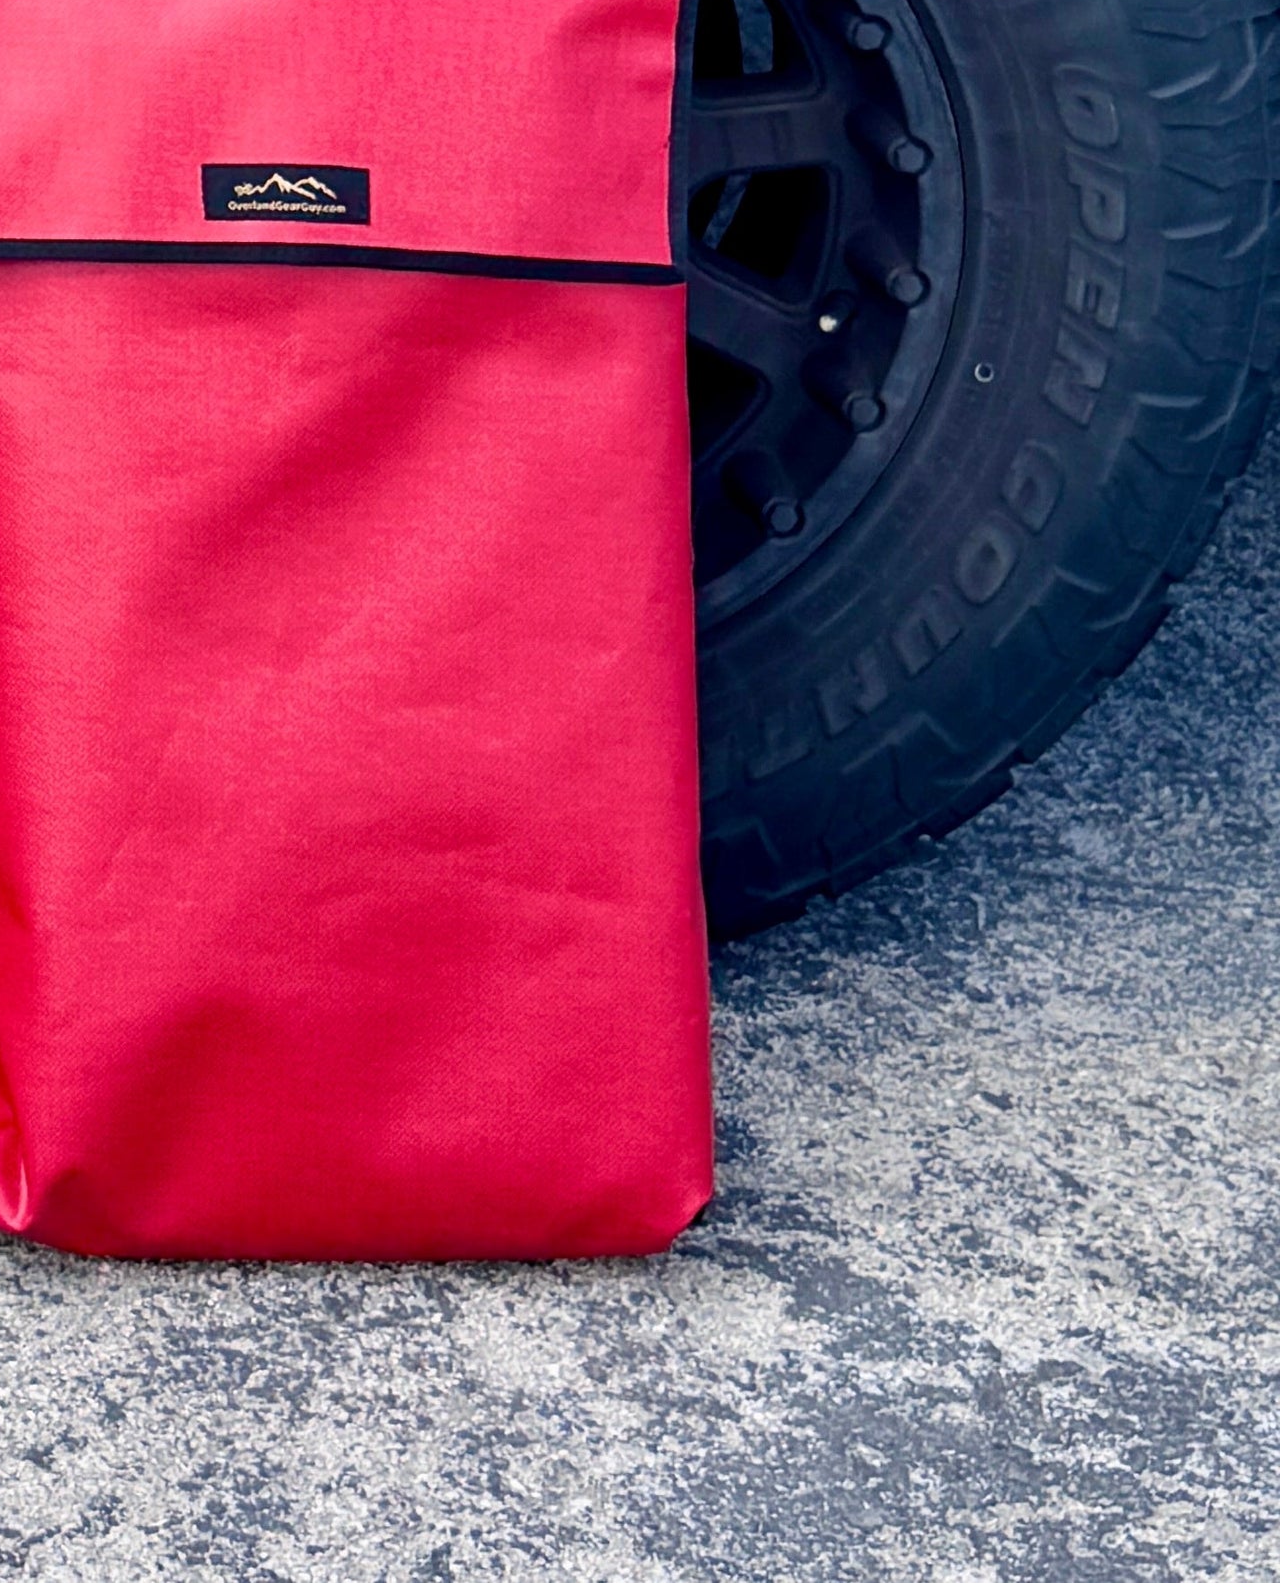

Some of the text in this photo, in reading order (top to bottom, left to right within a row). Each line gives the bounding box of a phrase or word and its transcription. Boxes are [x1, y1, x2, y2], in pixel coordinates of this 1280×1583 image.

[227, 200, 346, 215] OverlandGearGuy.com
[702, 65, 1127, 796] OPEN COUNT
